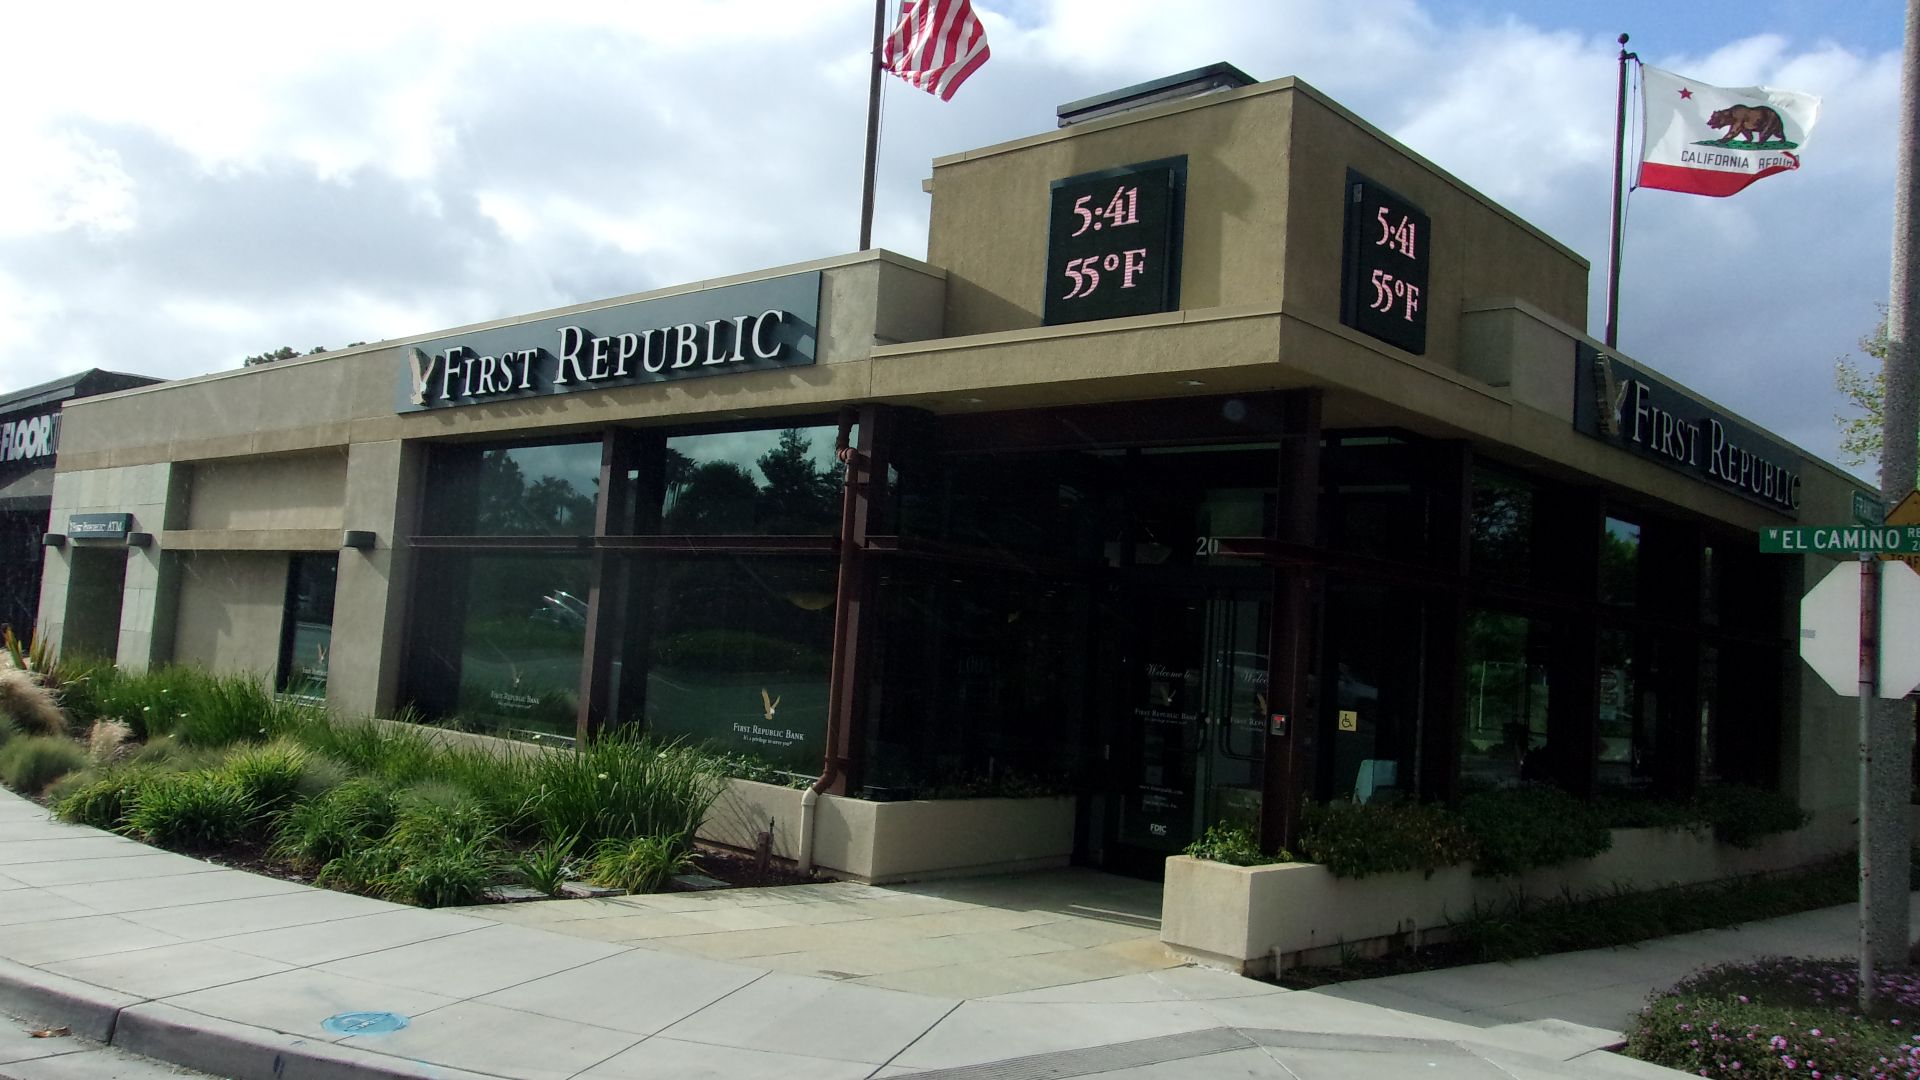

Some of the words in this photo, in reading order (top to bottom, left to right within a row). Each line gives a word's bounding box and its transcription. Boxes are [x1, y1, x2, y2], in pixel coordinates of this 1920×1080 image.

[1681, 150, 1749, 169] CALIFORNIA
[1071, 185, 1140, 238] 5:41
[1375, 206, 1417, 260] 5:41
[440, 345, 538, 401] FIRST
[552, 308, 784, 385] REPUBLIC
[1632, 380, 1700, 466] FIRST
[1708, 418, 1801, 510] REPUBLIC
[1769, 529, 1778, 540] W
[1782, 530, 1808, 549] EL
[1813, 529, 1900, 550] CAMINO
[1907, 527, 1920, 538] RE
[733, 722, 751, 733] FIRST
[752, 724, 784, 738] REPUBLIC
[785, 729, 805, 741] BANK
[1150, 823, 1168, 833] FDIC
